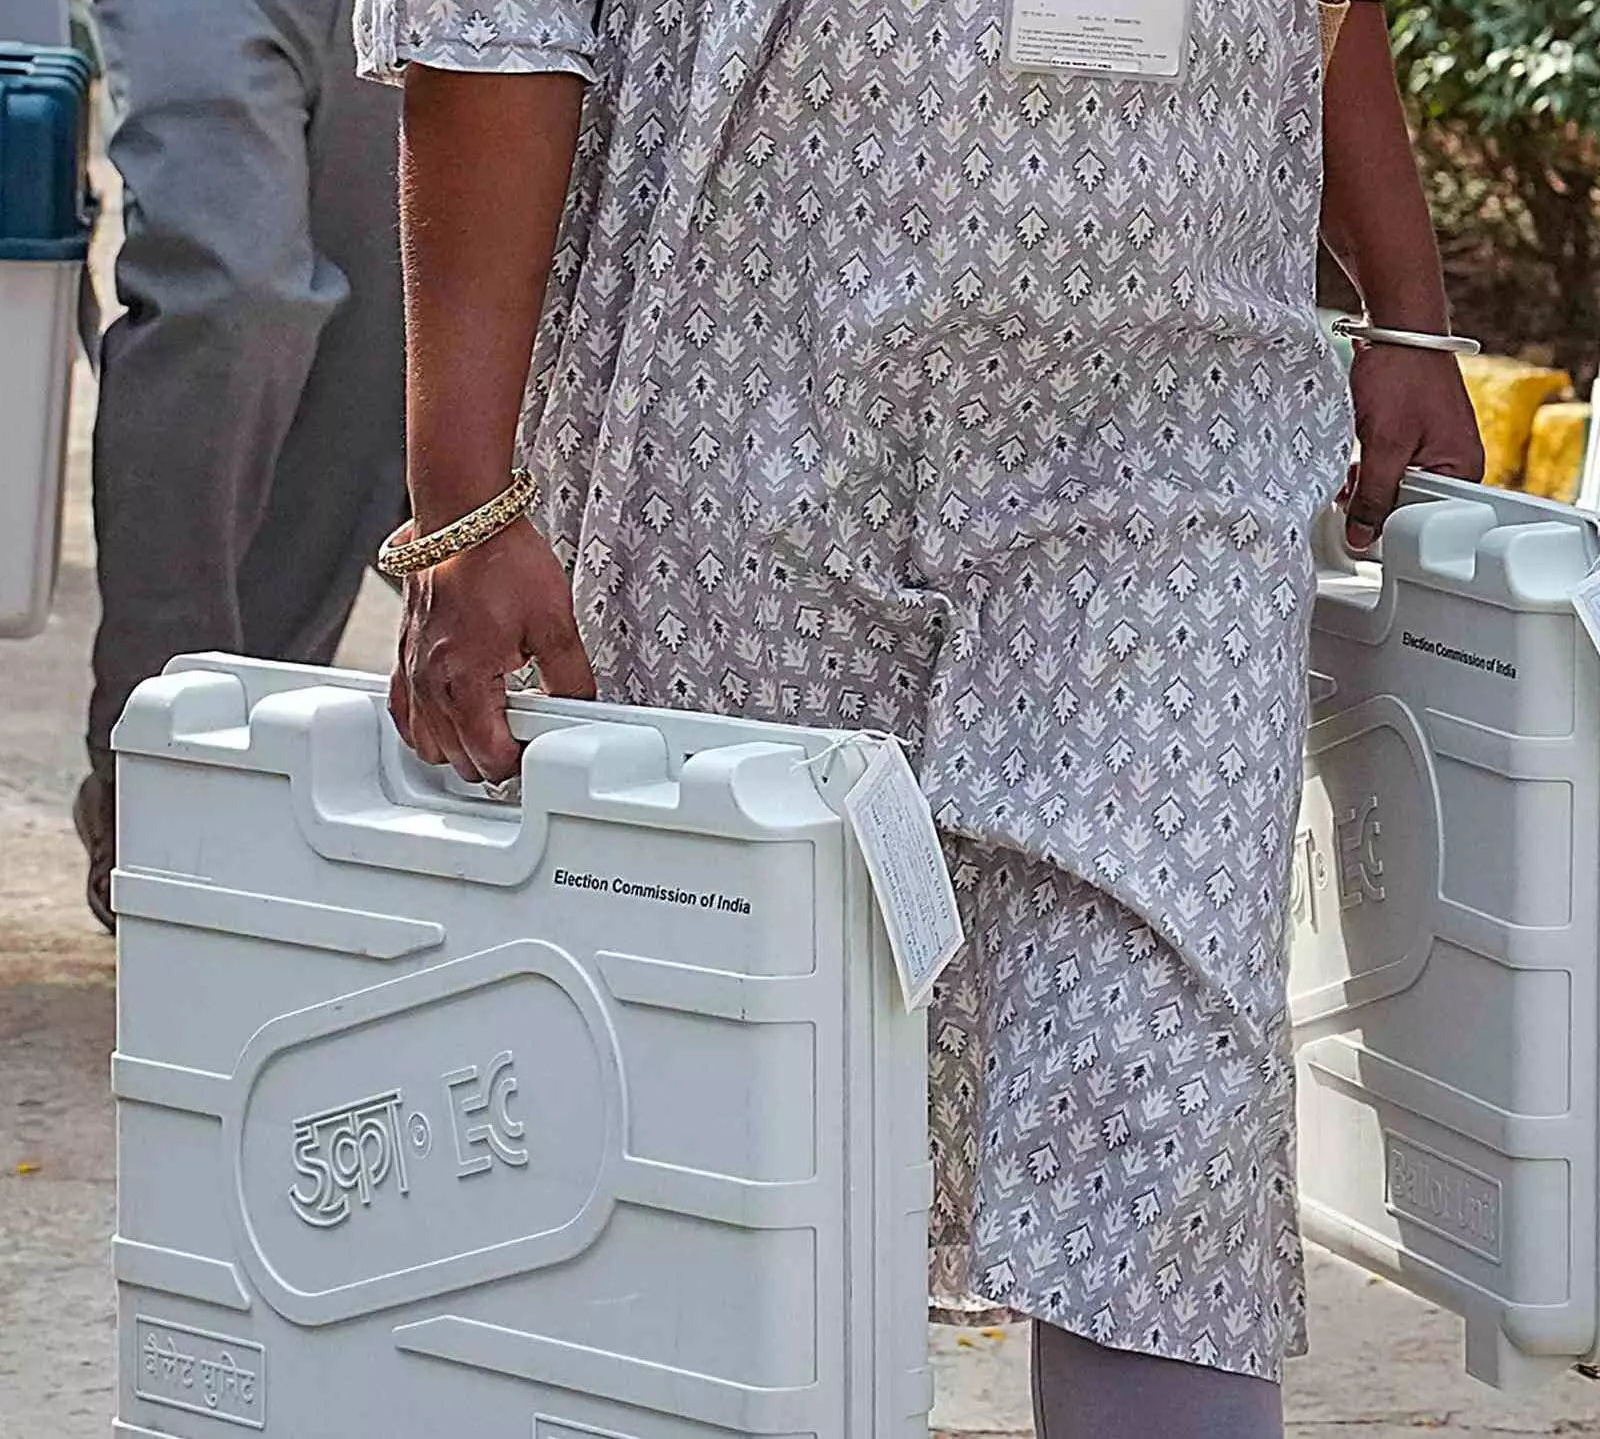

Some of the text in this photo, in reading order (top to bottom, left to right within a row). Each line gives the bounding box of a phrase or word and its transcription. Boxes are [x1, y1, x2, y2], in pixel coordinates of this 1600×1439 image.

[1402, 631, 1517, 679] Election Commission of India
[554, 869, 750, 914] Election Commission of India
[440, 1049, 529, 1180] EC
